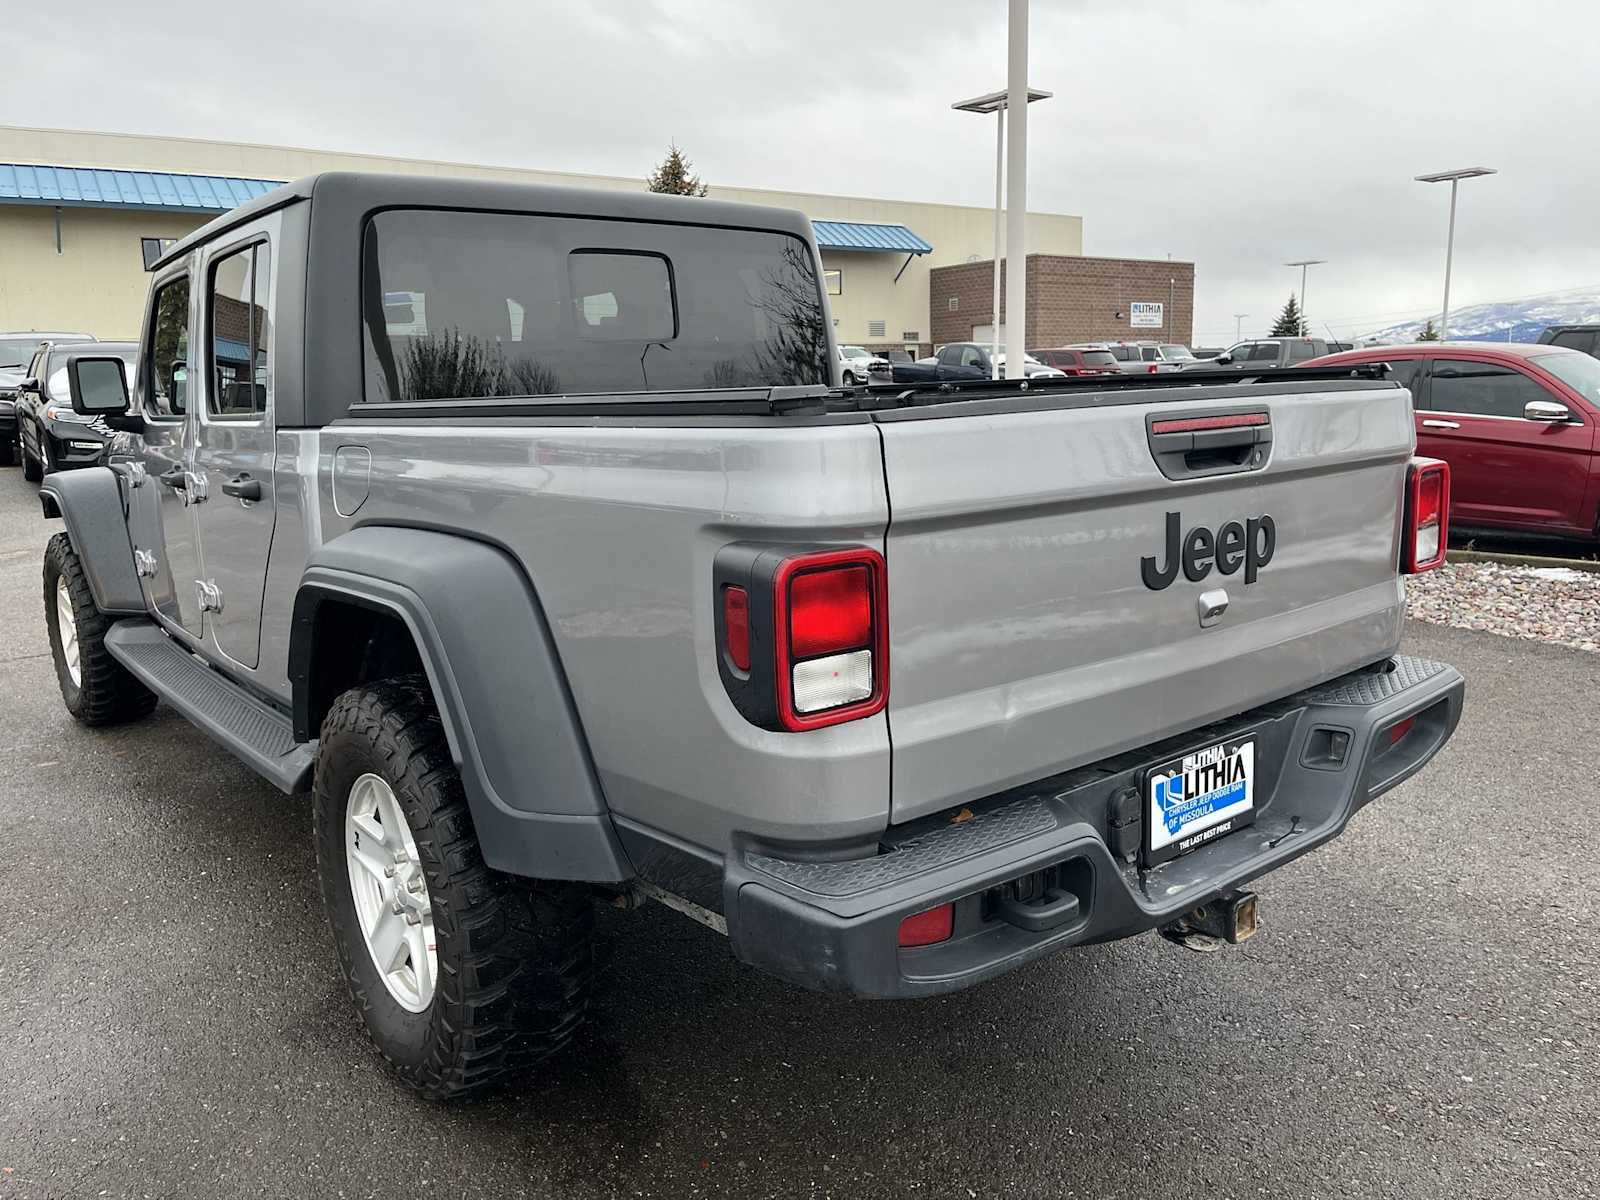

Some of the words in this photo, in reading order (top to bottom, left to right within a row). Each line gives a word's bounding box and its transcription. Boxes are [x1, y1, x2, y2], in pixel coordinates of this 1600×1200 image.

[1138, 304, 1161, 313] LITHIA
[1140, 511, 1276, 591] Jeep
[1192, 744, 1226, 769] LITHIA
[1184, 753, 1246, 801] LITHIA
[1168, 799, 1198, 817] CHRYSLER
[1198, 792, 1212, 807] JEEP
[1212, 786, 1231, 801] DODGE
[1230, 781, 1244, 793] RAM
[1168, 817, 1179, 830] OF
[1180, 802, 1214, 824] MISSOULA
[1179, 841, 1190, 851] THE
[1190, 834, 1204, 846] LAST
[1204, 827, 1217, 840] BEST
[1216, 821, 1232, 835] PRICE
